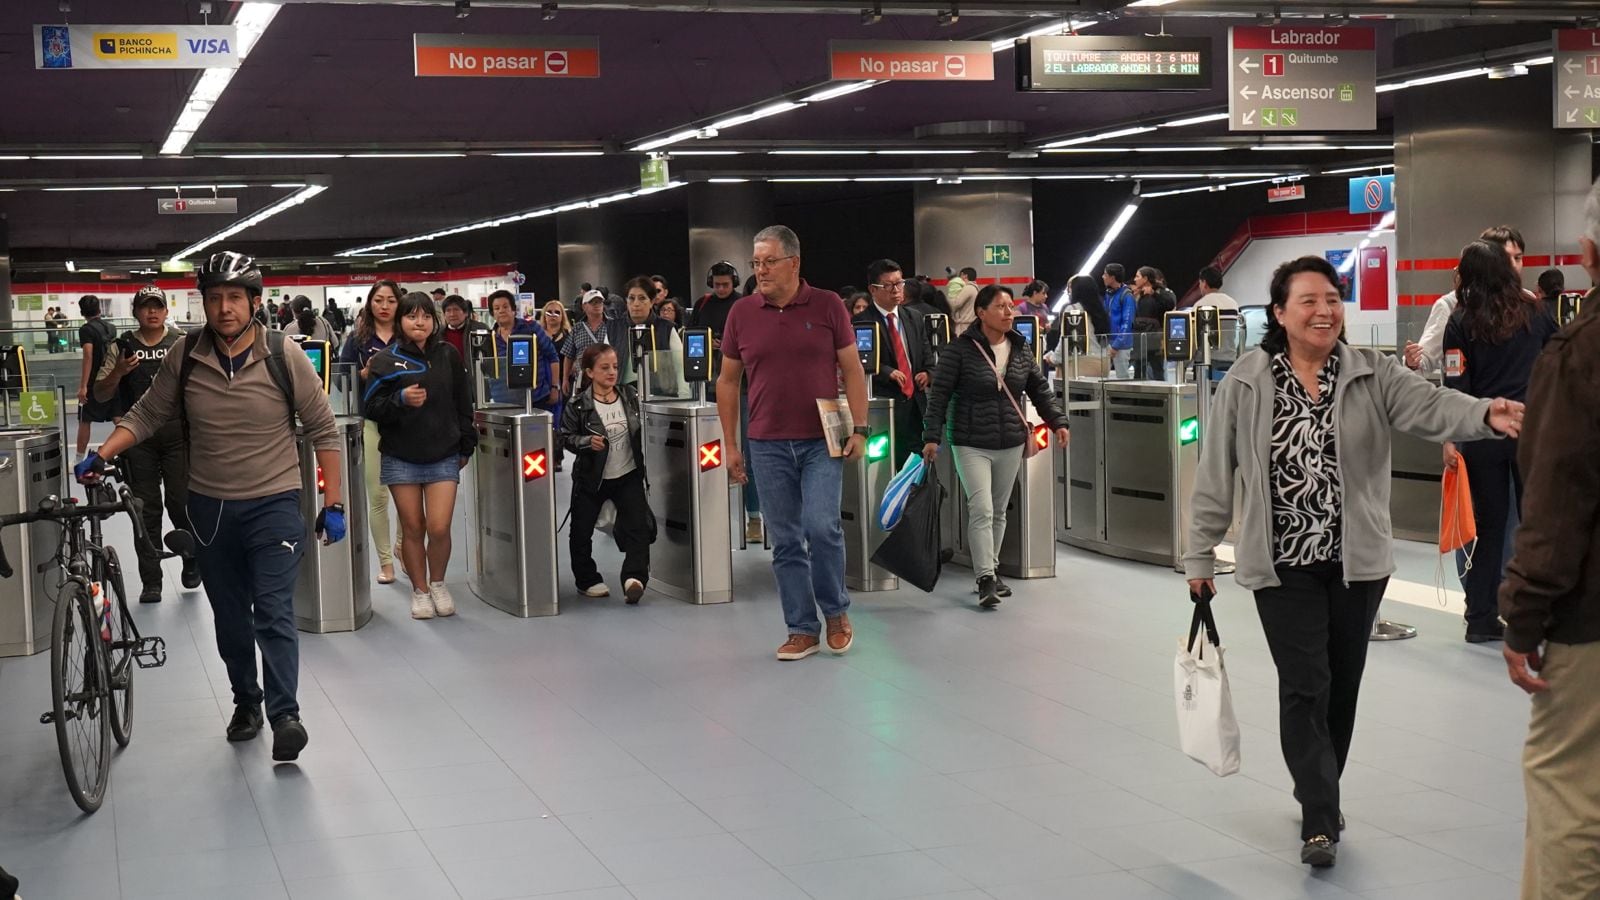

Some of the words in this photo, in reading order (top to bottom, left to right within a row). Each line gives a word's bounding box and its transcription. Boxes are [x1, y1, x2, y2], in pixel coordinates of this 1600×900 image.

[119, 38, 153, 46] BANCO
[1271, 29, 1340, 44] Labrador
[119, 46, 173, 55] PICHINCHA
[186, 39, 231, 54] VISA
[449, 52, 477, 69] No
[483, 56, 538, 73] pasar
[1053, 52, 1101, 62] QUITUMBE
[1121, 52, 1150, 62] ANDEN
[1155, 52, 1162, 62] 2
[1169, 52, 1176, 62] 6
[1181, 52, 1199, 62] MIN
[1268, 56, 1277, 74] 1
[1288, 53, 1339, 64] Quitumbe
[860, 57, 884, 73] No
[889, 60, 938, 77] pasar
[1044, 63, 1052, 73] 2
[1053, 63, 1066, 73] EL
[1071, 63, 1118, 73] LABRADOR
[1120, 63, 1150, 73] ANDEN
[1156, 63, 1162, 73] 1
[1169, 63, 1176, 73] 6
[1181, 63, 1199, 73] MIN
[1590, 57, 1598, 74] 1
[1261, 84, 1335, 100] Ascensor
[132, 348, 168, 360] OLICI
